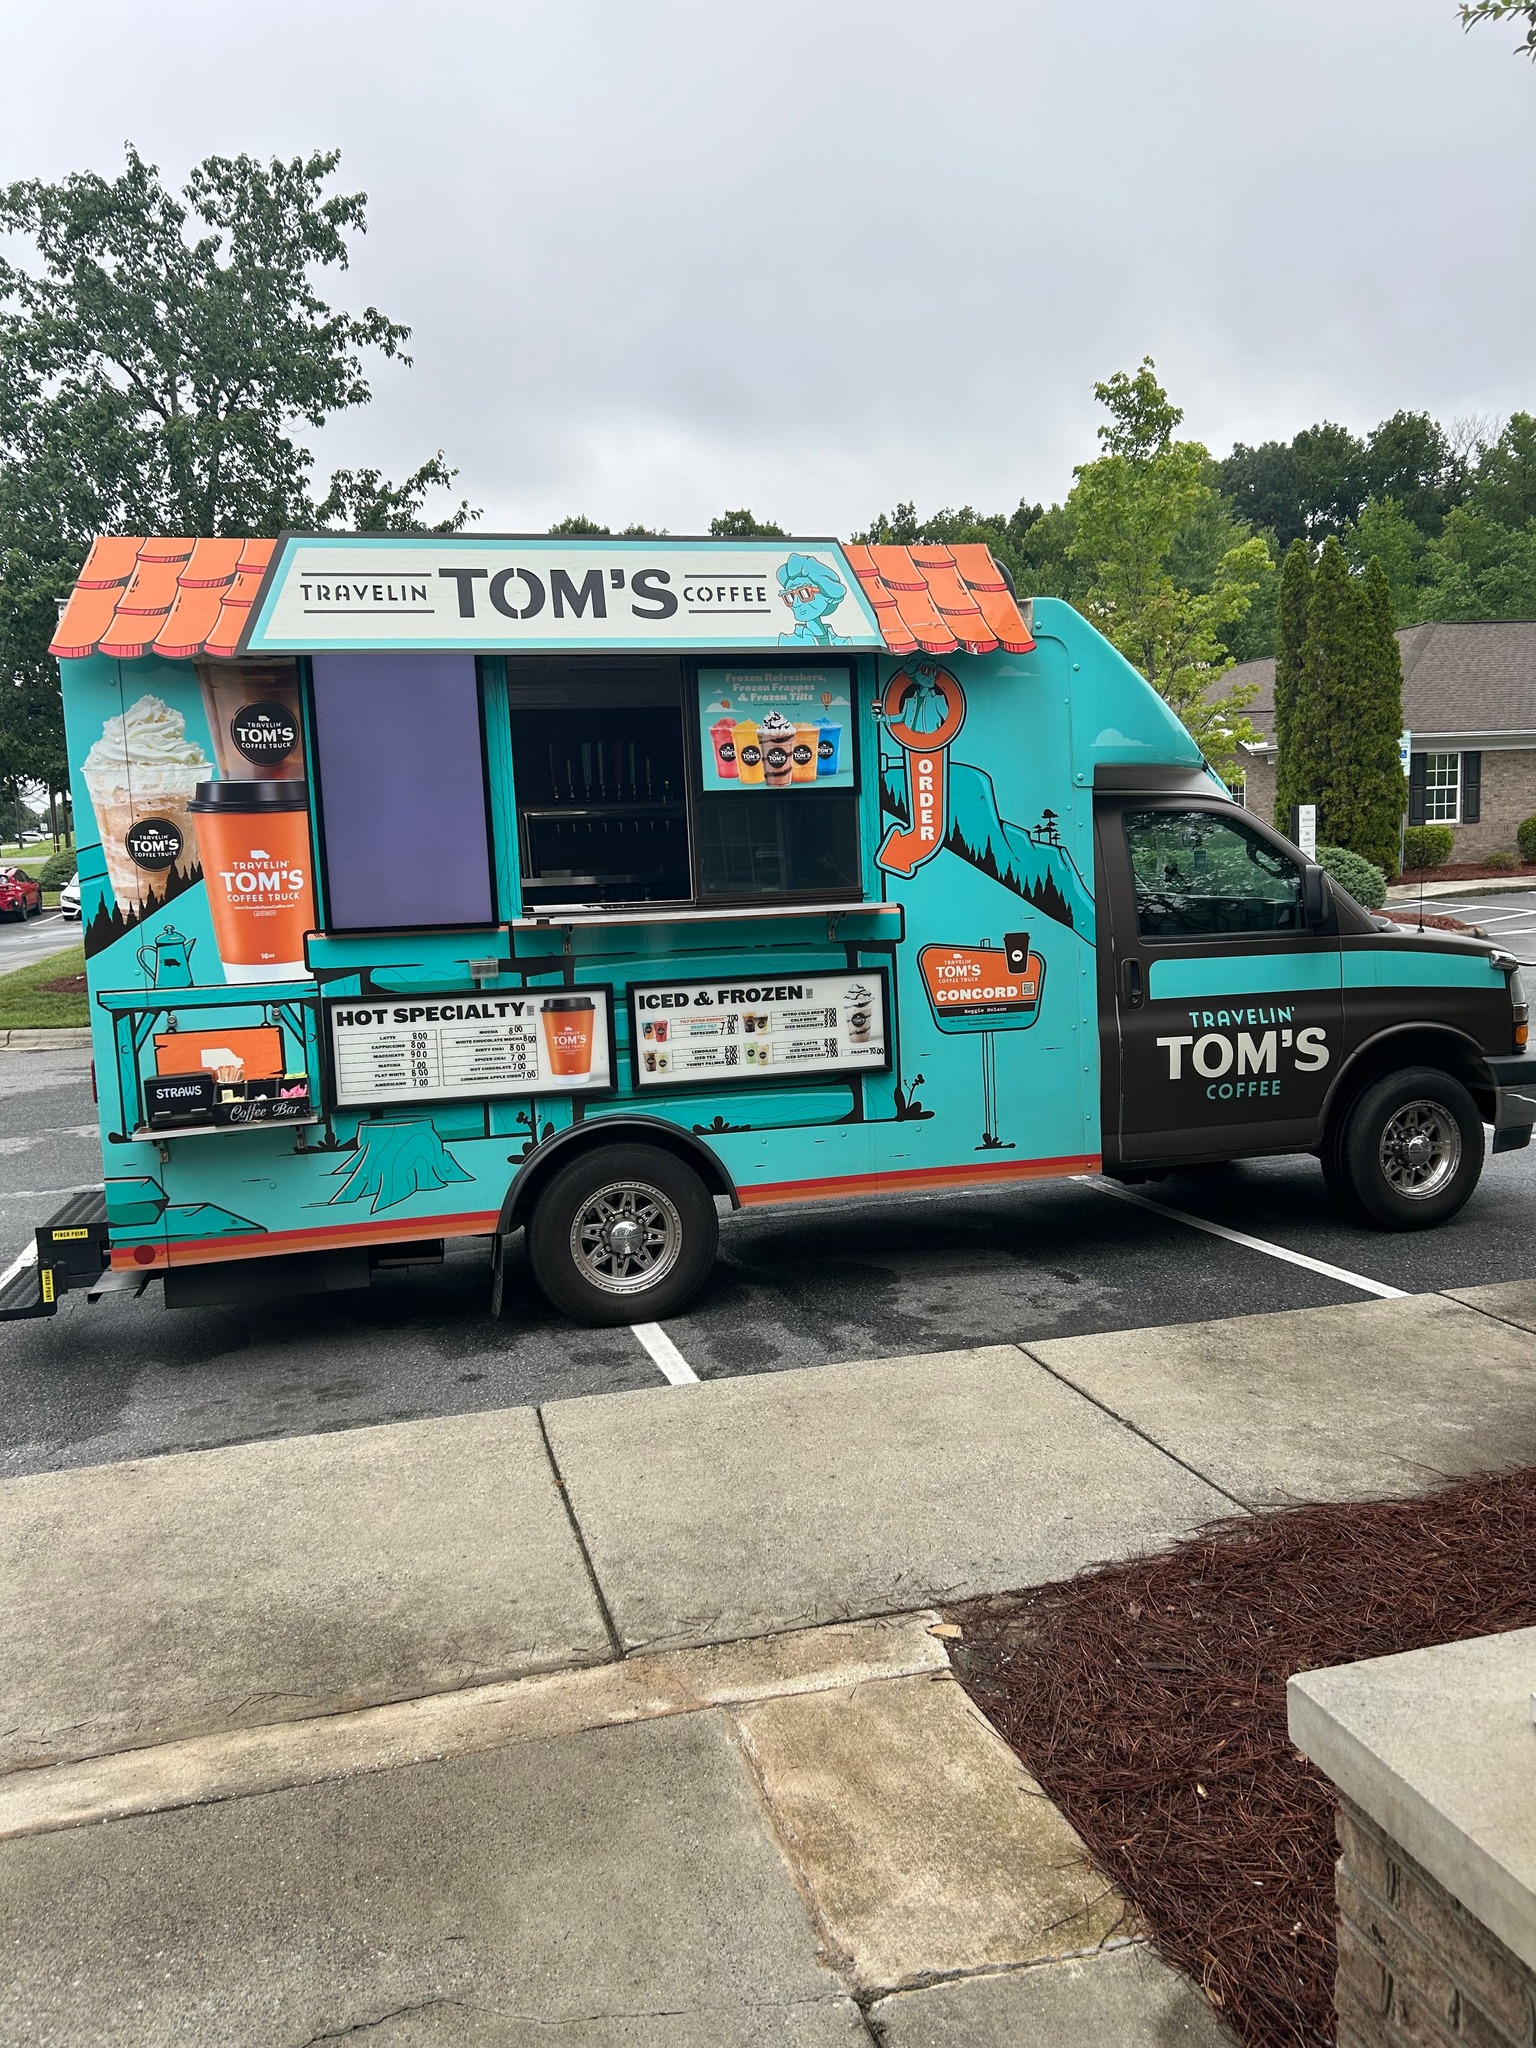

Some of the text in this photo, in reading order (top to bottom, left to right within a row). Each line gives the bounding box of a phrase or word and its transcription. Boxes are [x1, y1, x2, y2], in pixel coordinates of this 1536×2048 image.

[300, 567, 767, 620] TRAVELIN TOM'S COFFEE
[725, 673, 826, 683] Frozen Refreshers,
[732, 683, 815, 692] Frozen Frappes
[738, 692, 814, 702] & Frozen Tilts
[236, 727, 294, 743] TOM'S
[241, 742, 267, 750] COFFEE
[918, 758, 935, 841] ORDER
[130, 838, 180, 853] TOM'S
[232, 860, 290, 870] TRAVELIN'
[219, 869, 304, 893] TOM'S
[227, 892, 300, 903] COFFEE TRUCK
[935, 964, 982, 978] TOM'S
[638, 985, 803, 1010] ICED & FROZEN
[936, 985, 1018, 1002] CONCORD
[336, 1002, 526, 1027] HOT SPECIALTY
[1188, 1006, 1295, 1028] TRAVELIN'
[552, 1034, 587, 1045] TOM'S
[1156, 1027, 1330, 1080] TOM'S
[156, 1085, 202, 1099] STRAWS
[1206, 1080, 1281, 1100] COFFEE
[230, 1101, 300, 1122] Coffee Bar
